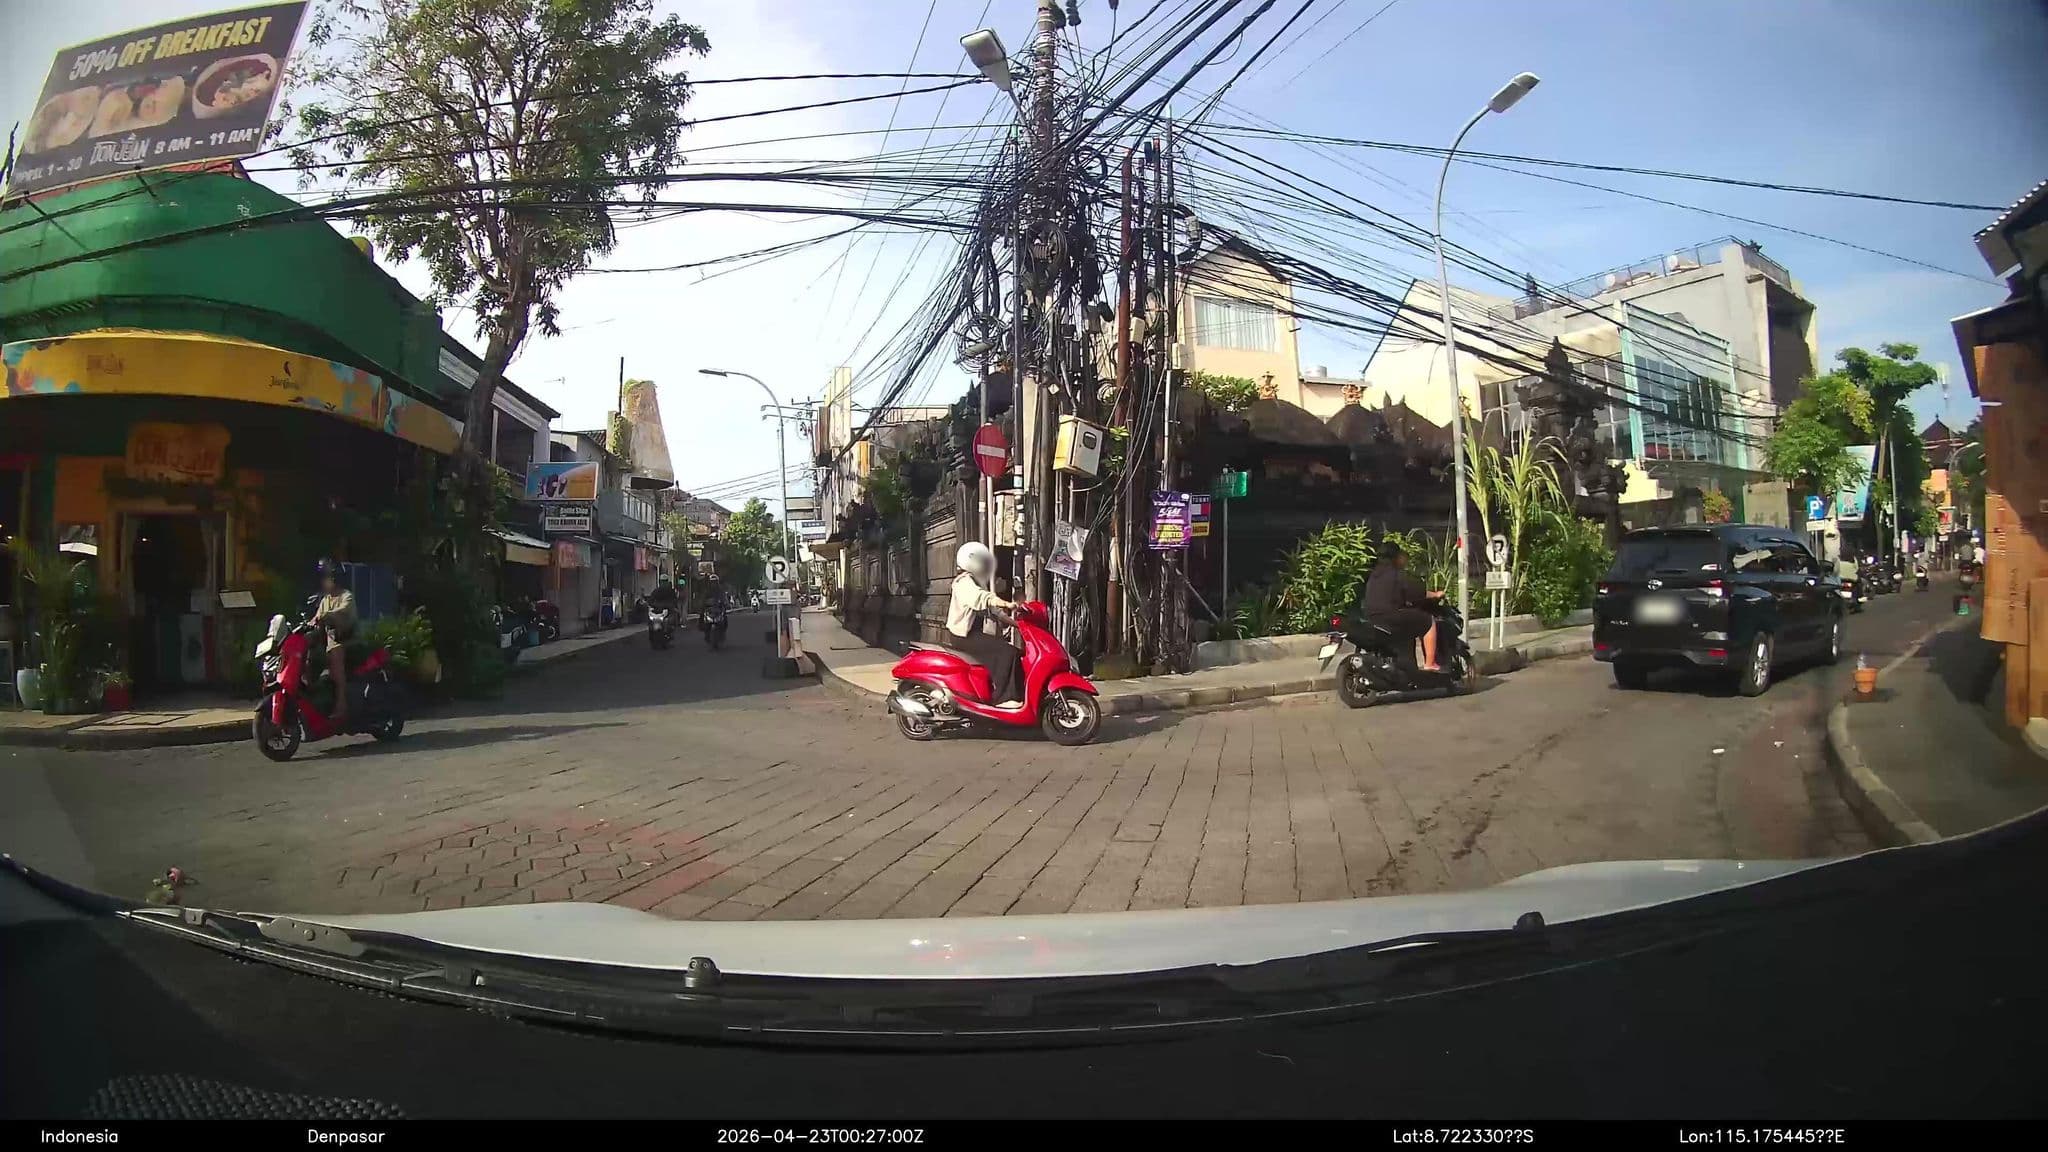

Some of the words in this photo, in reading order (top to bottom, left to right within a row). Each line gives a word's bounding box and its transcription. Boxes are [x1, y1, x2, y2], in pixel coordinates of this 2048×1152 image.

[70, 47, 118, 81] 50%
[117, 36, 156, 68] OFF
[156, 17, 272, 59] BREAKFAST
[168, 137, 192, 152] AM
[1809, 501, 1820, 519] P
[1493, 540, 1504, 562] P
[771, 561, 785, 581] P
